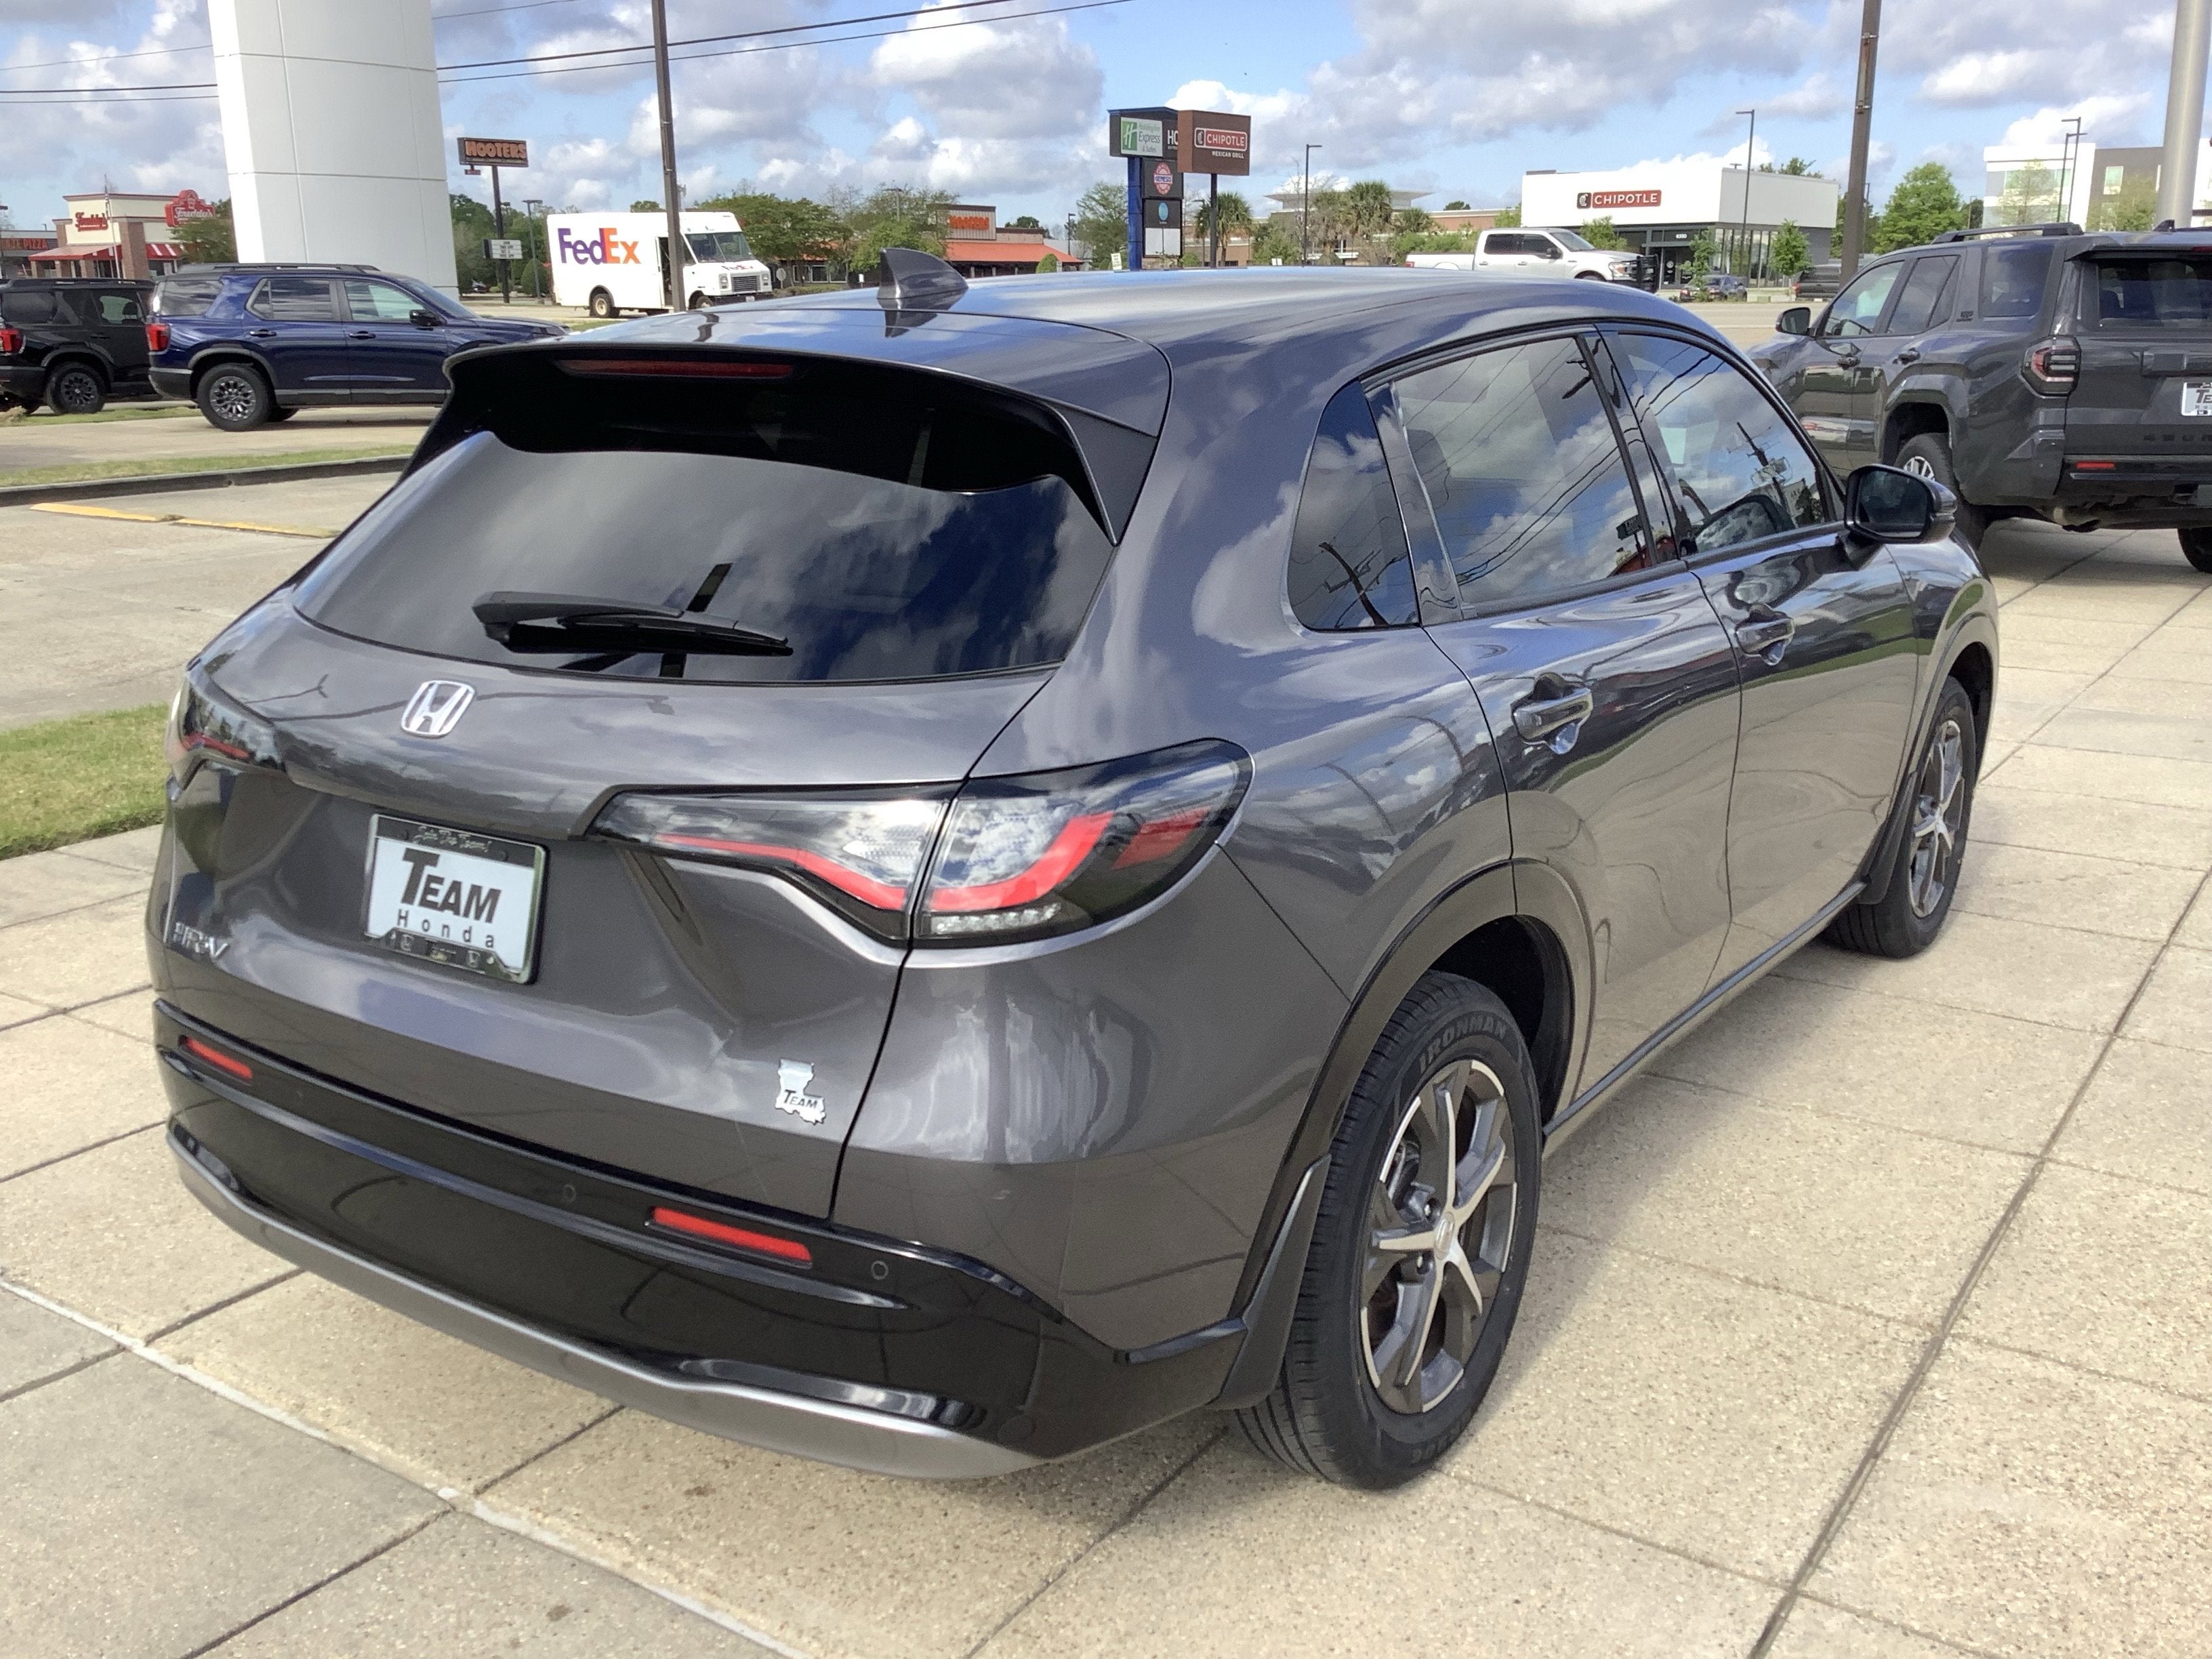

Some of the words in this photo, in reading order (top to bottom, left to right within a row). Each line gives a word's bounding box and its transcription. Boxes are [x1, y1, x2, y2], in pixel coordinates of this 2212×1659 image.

[1139, 131, 1161, 144] Express
[1206, 134, 1245, 146] CHIPOTLE
[465, 141, 527, 159] HOOTERS
[1594, 192, 1658, 205] CHIPOTLE
[558, 228, 641, 265] FedEx
[401, 847, 501, 923] TEAM
[396, 909, 495, 949] Honda
[783, 1088, 818, 1109] TEAM
